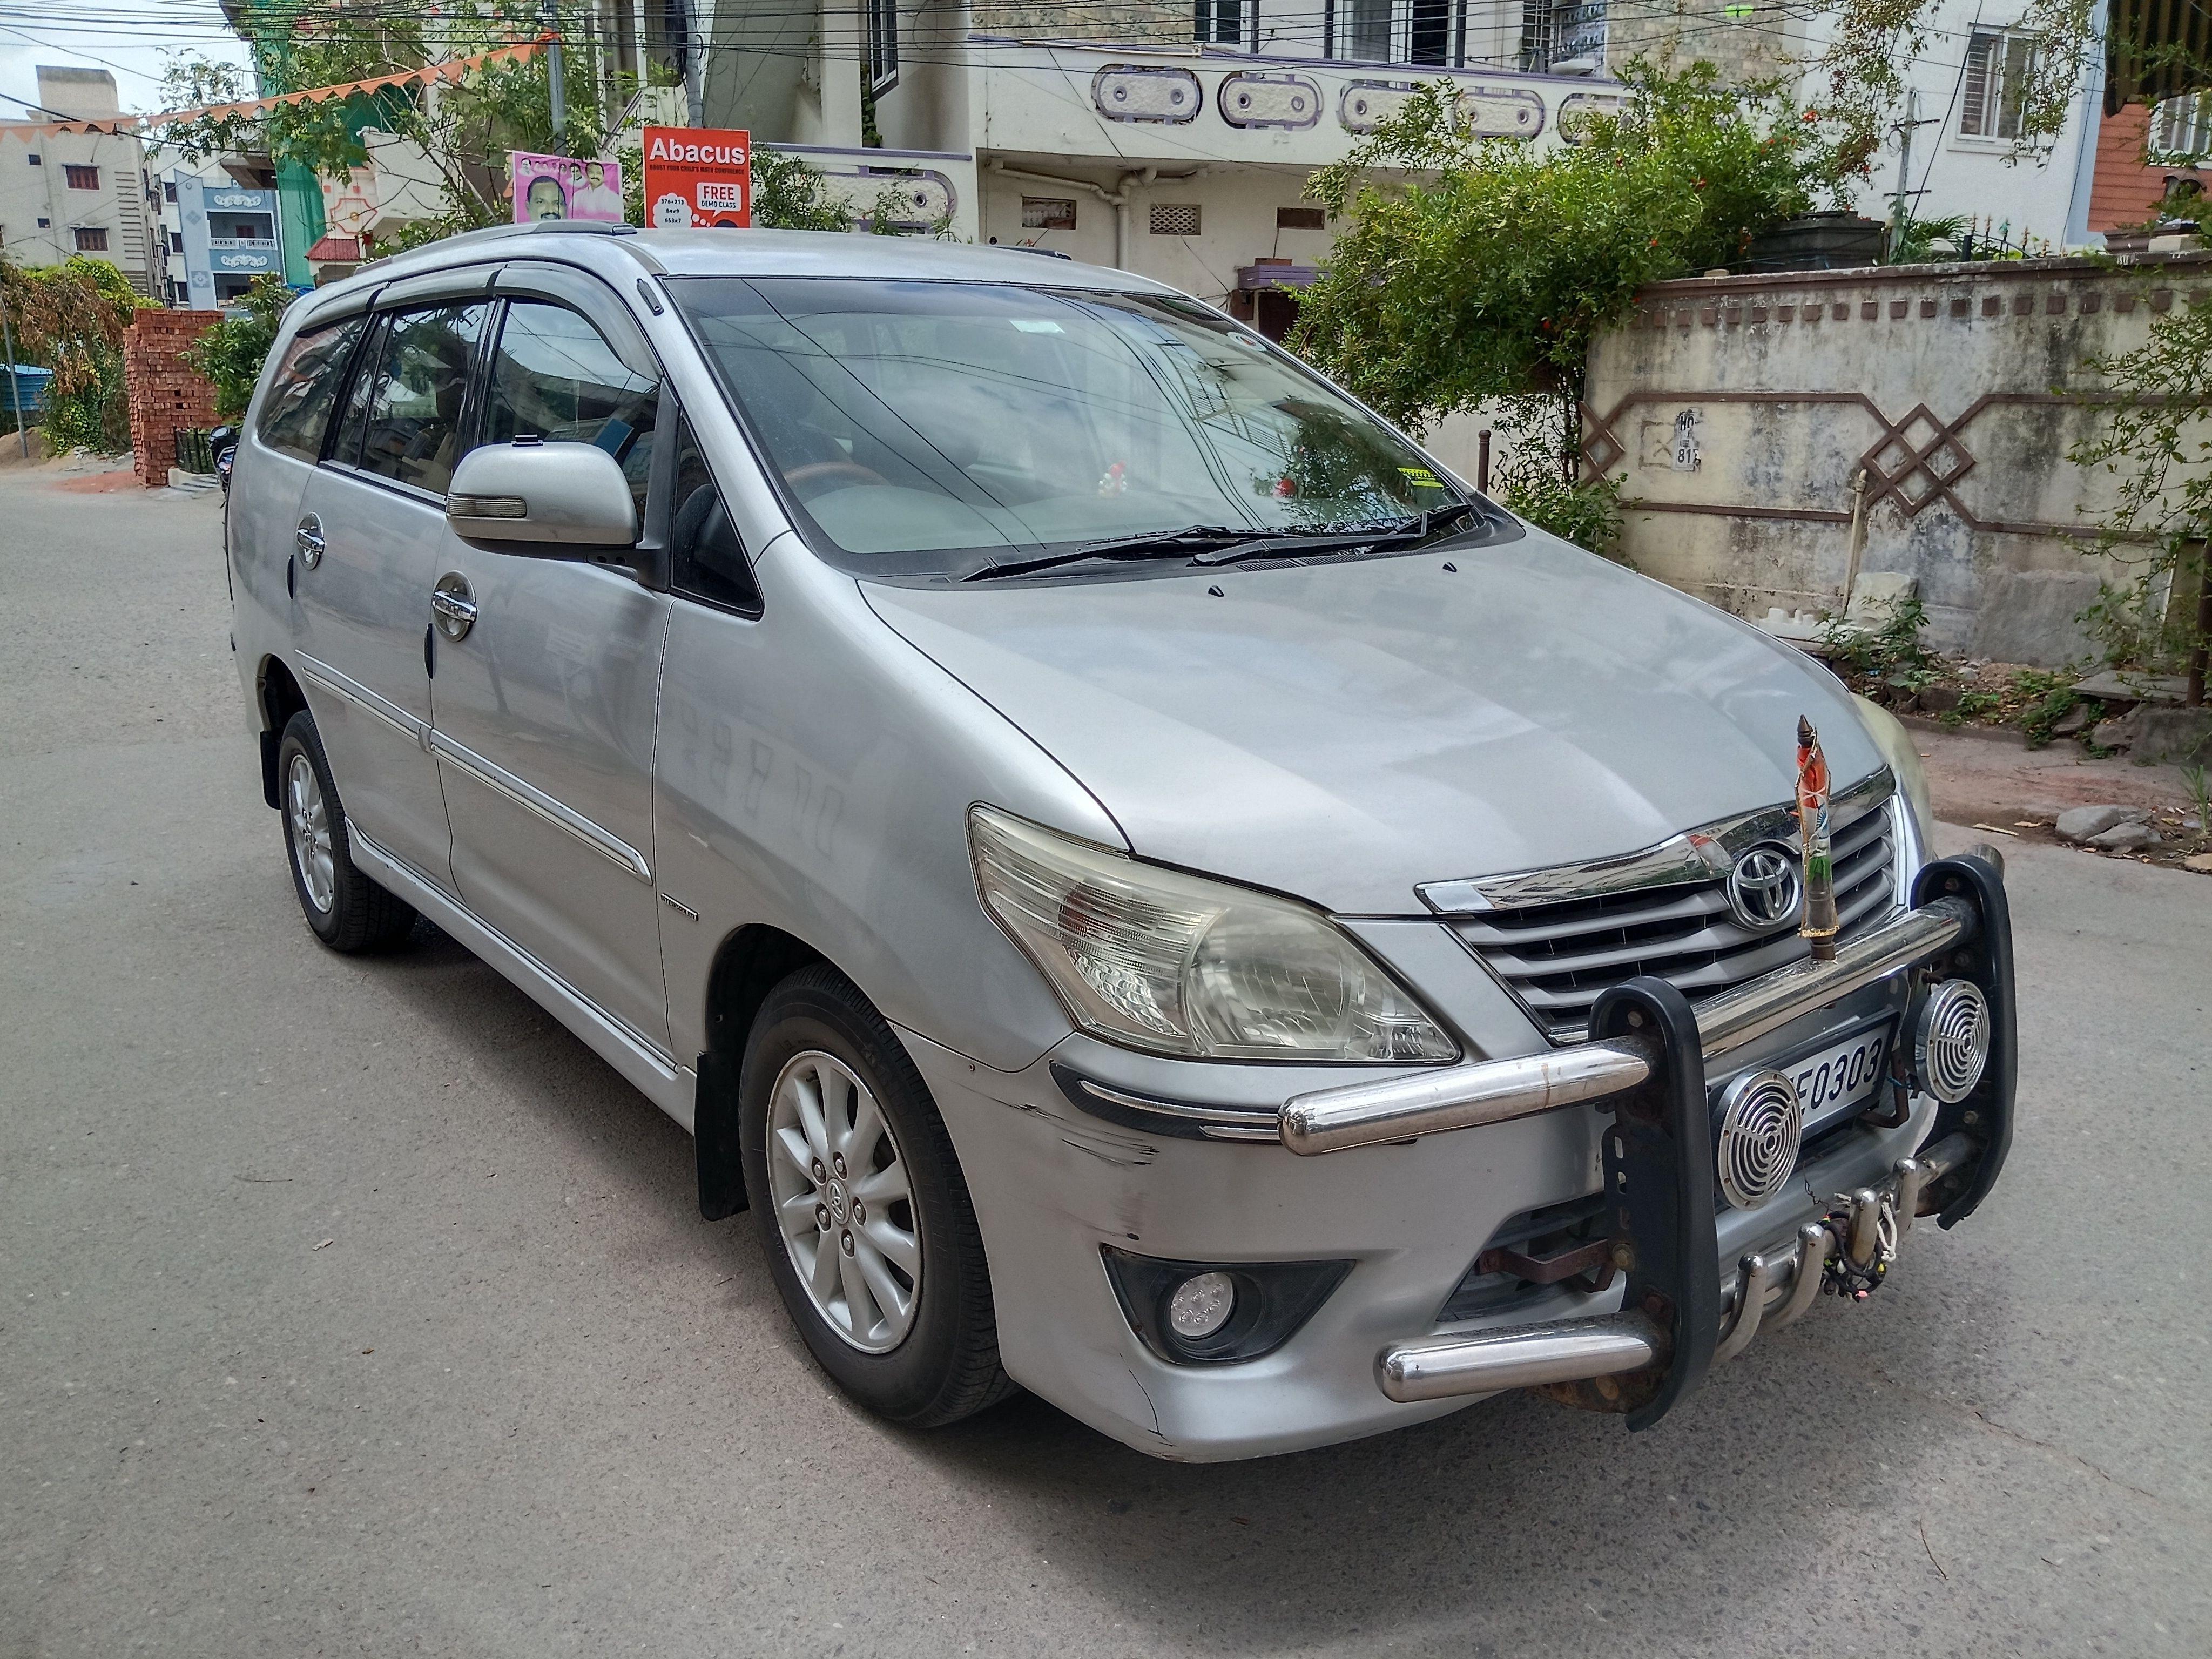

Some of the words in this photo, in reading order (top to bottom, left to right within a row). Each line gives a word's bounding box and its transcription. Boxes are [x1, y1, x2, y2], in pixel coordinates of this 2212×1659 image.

[649, 138, 746, 165] Abacus
[704, 186, 734, 200] FREE
[1790, 1037, 1883, 1116] E0303
